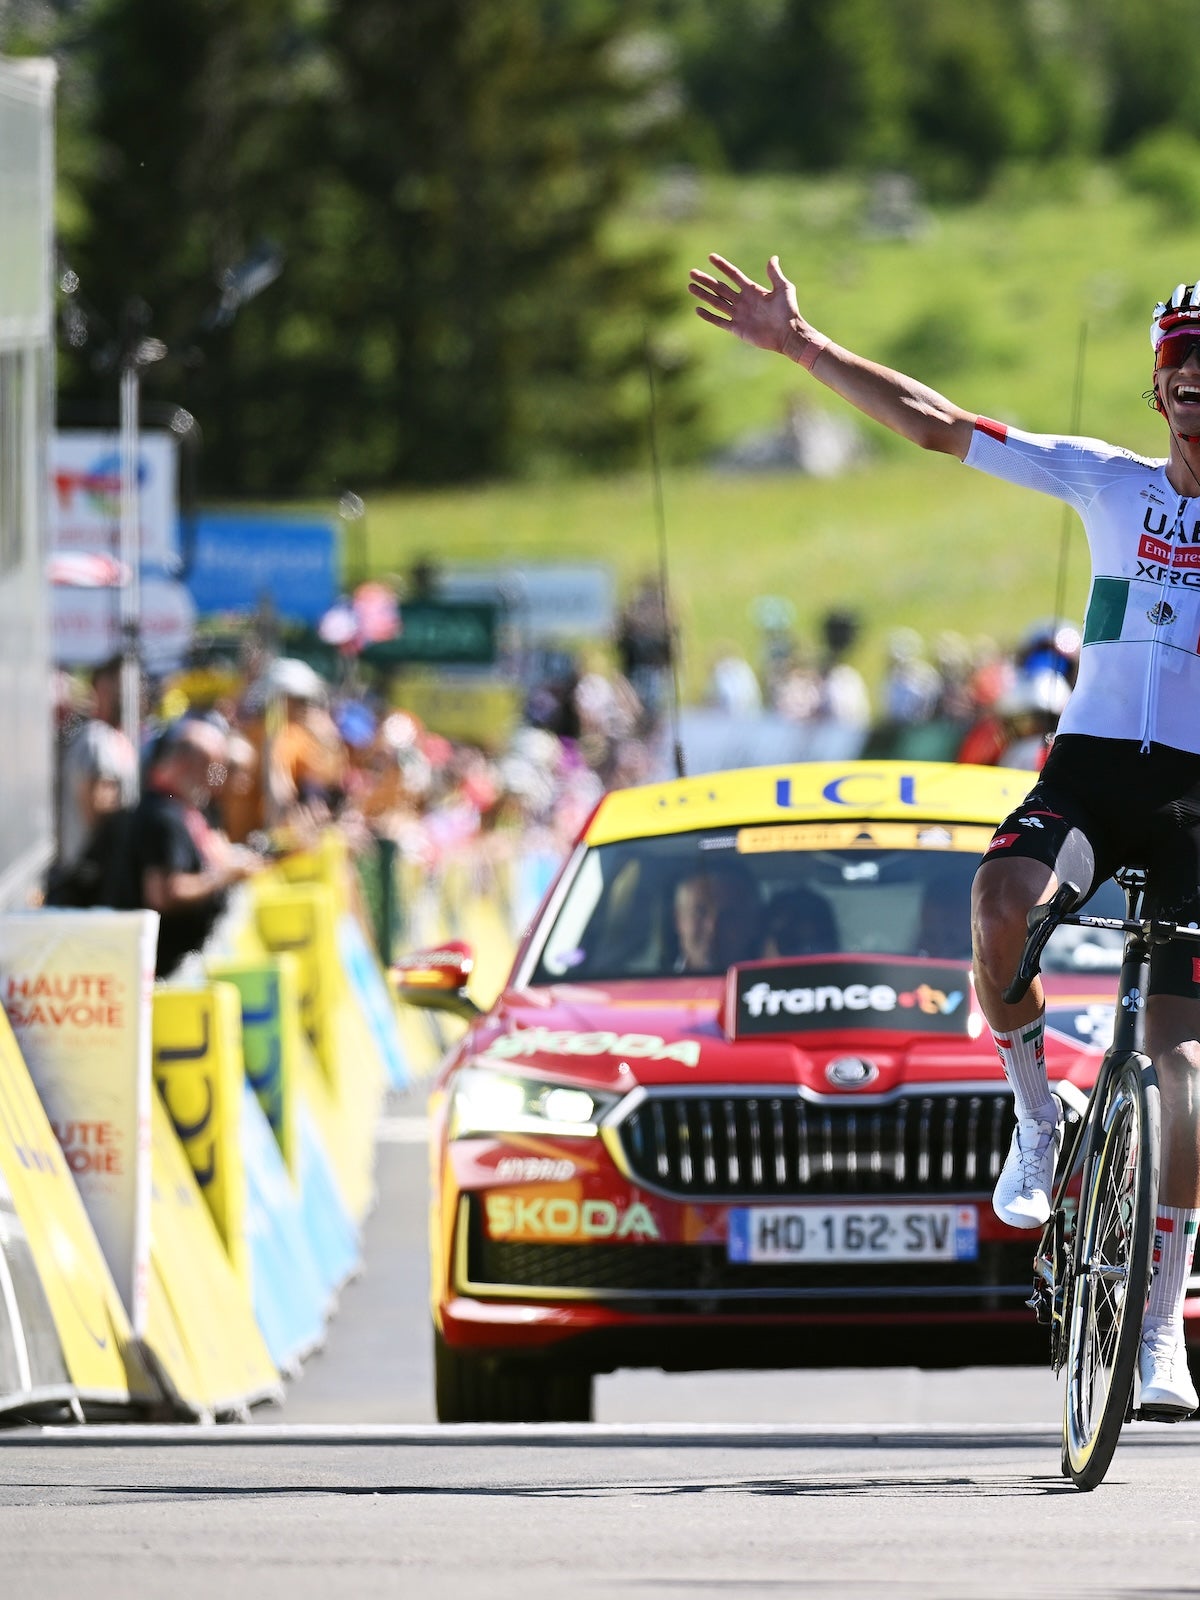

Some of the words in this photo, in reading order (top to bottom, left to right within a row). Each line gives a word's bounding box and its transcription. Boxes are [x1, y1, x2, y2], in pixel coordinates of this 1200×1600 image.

[776, 775, 948, 808] LCL
[7, 973, 125, 1001] HAUTE-
[7, 1002, 124, 1028] SAVOIE
[51, 1120, 124, 1145] UTE-
[65, 1149, 124, 1175] OIE
